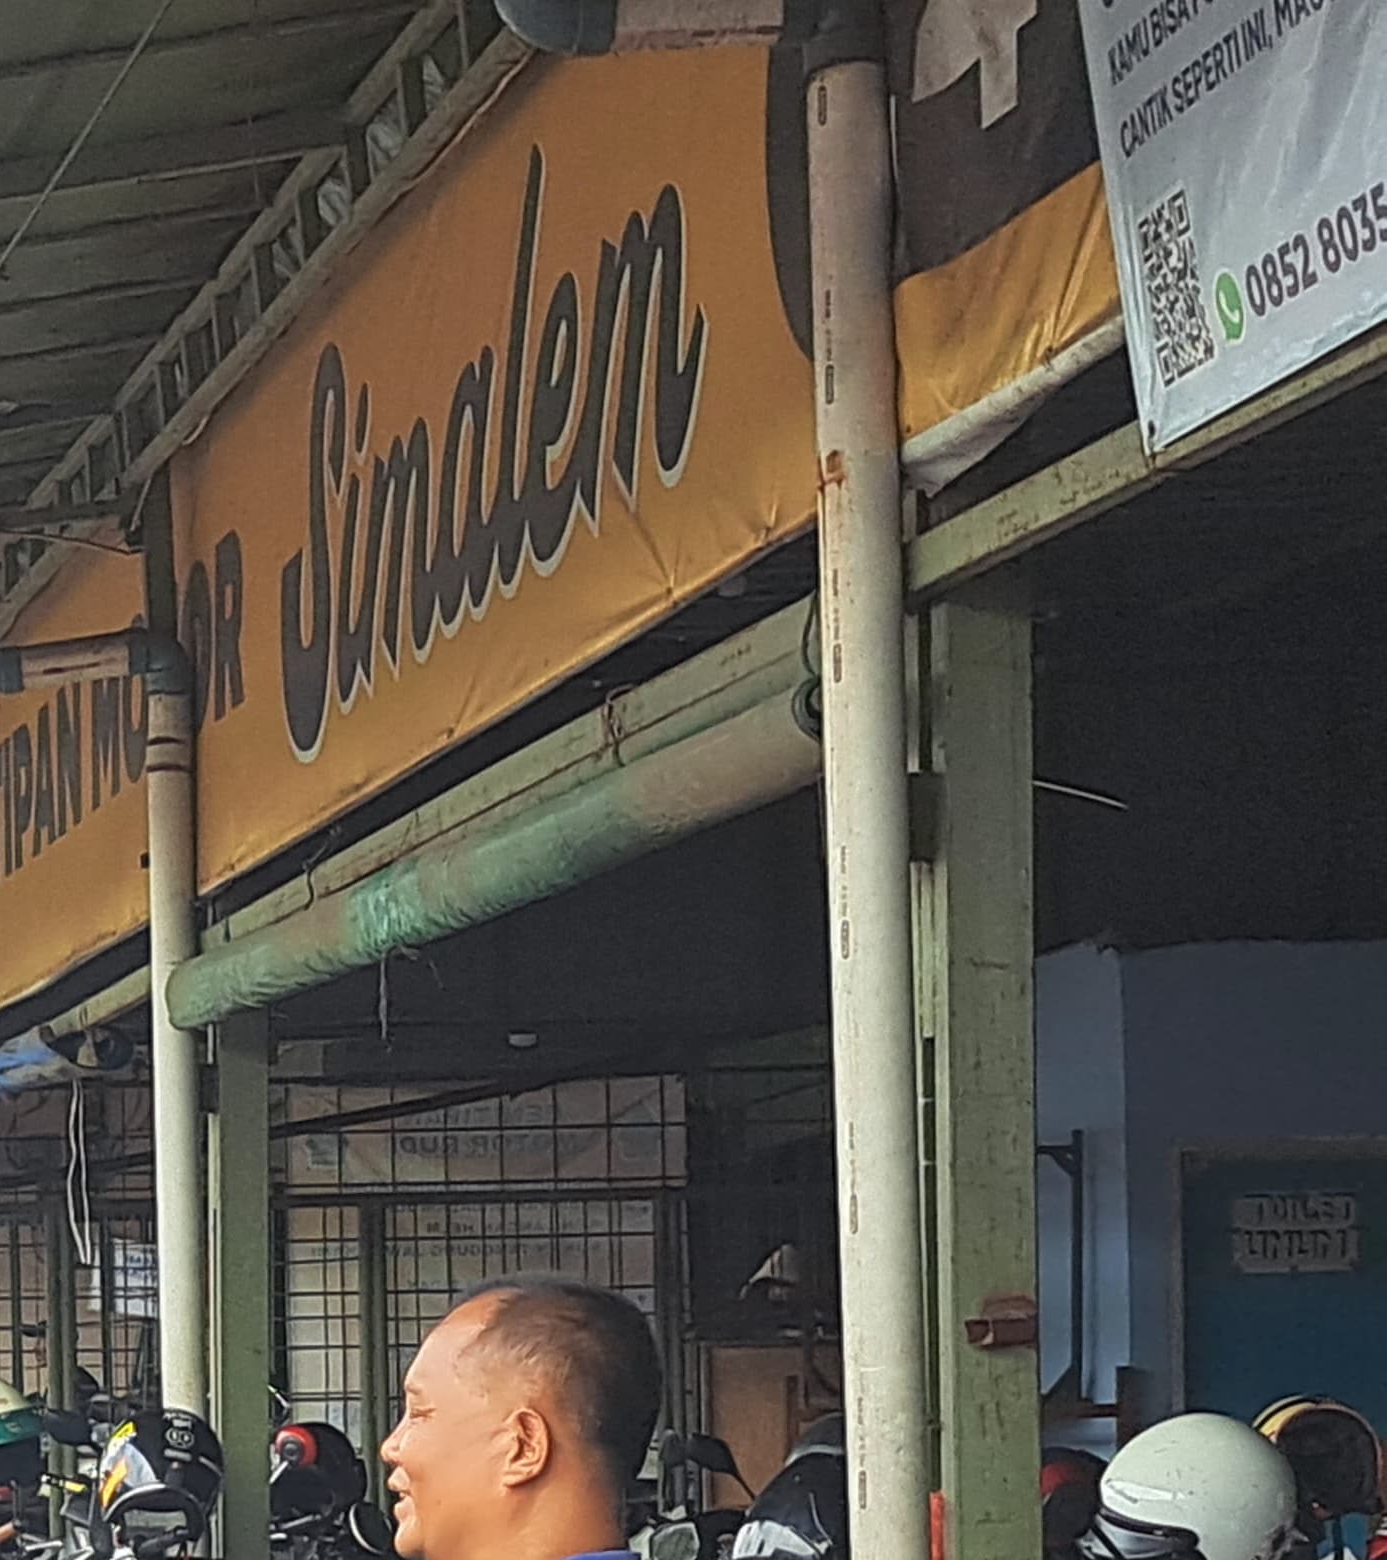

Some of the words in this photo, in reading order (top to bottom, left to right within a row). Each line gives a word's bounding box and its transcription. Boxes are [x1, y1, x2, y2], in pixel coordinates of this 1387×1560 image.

[1107, 17, 1150, 86] KAMU
[1153, 0, 1191, 48] BISA
[1120, 84, 1174, 158] CANTIK
[1171, 25, 1243, 114] SEPERTI
[1245, 233, 1318, 318] 0852
[91, 529, 246, 812] MOOR
[279, 143, 709, 764] Simalem
